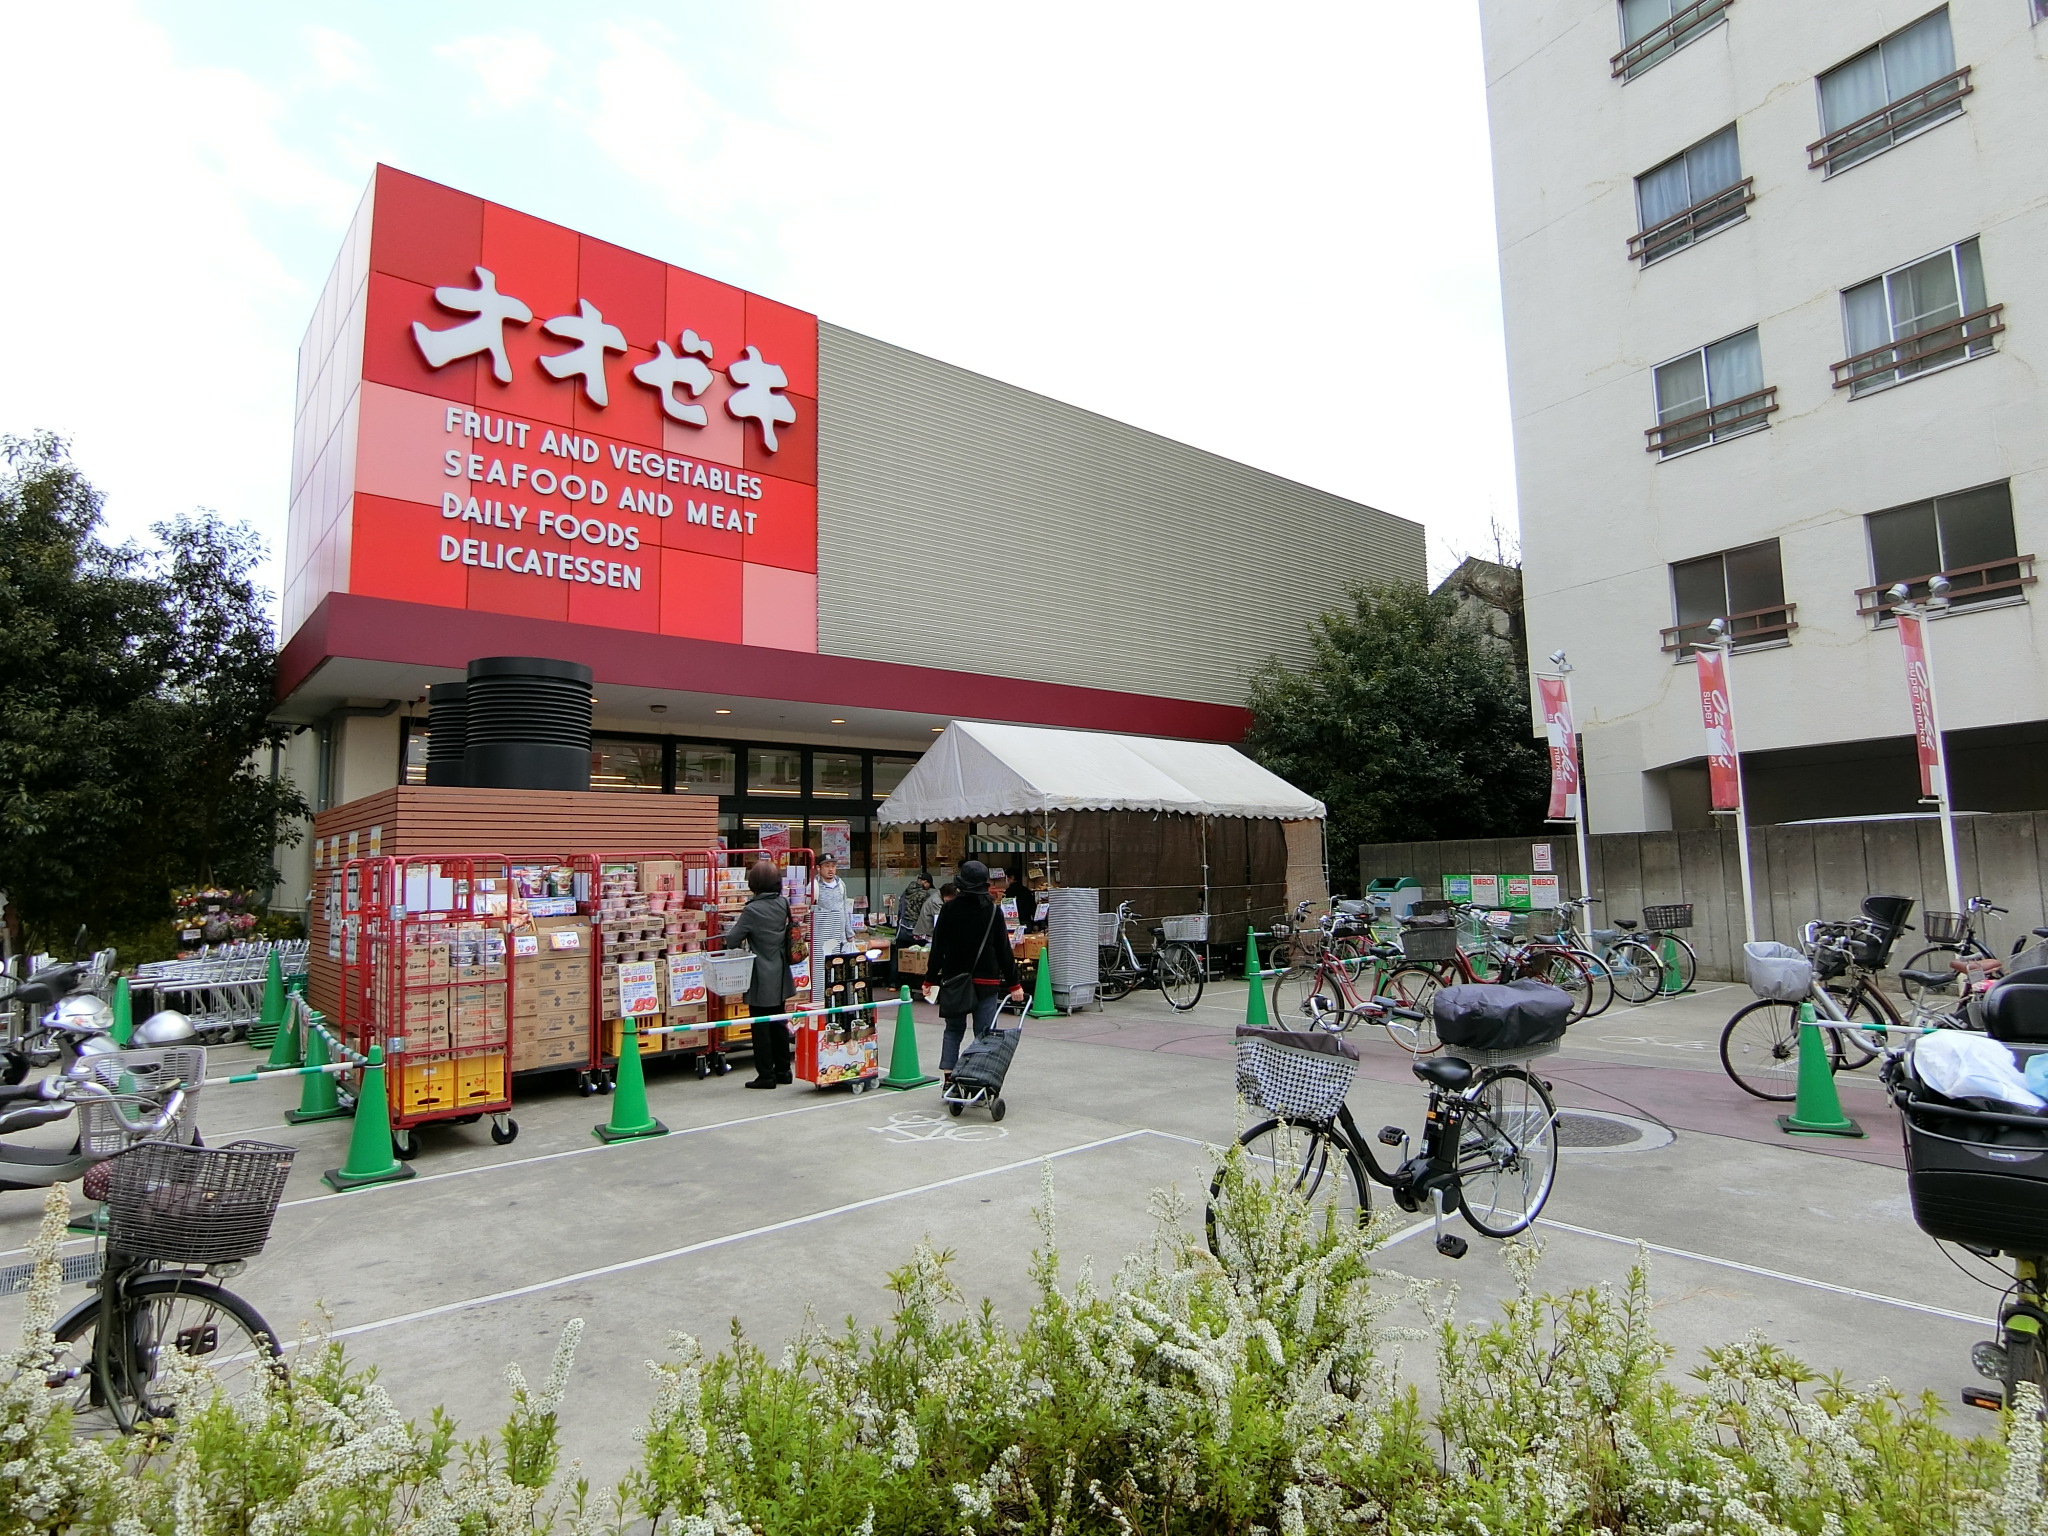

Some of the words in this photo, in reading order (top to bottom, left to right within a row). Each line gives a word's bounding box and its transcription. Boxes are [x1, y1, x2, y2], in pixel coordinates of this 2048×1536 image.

[411, 265, 797, 455] オオゼキ
[446, 407, 530, 448] FRUIT
[540, 429, 600, 464] AND
[609, 444, 763, 500] VEGETABLES
[442, 492, 528, 531] DAILY
[539, 510, 640, 552] FOODS
[444, 450, 609, 504] SEAFOOD
[619, 486, 674, 518] AND
[687, 503, 758, 535] MEAT
[440, 535, 641, 592] DELICATESSEN
[1703, 691, 1712, 724] super
[1908, 662, 1919, 698] super
[1915, 703, 1927, 748] market
[1914, 661, 1935, 750] Ozeki
[632, 996, 658, 1012] 89
[681, 986, 706, 1002] 89
